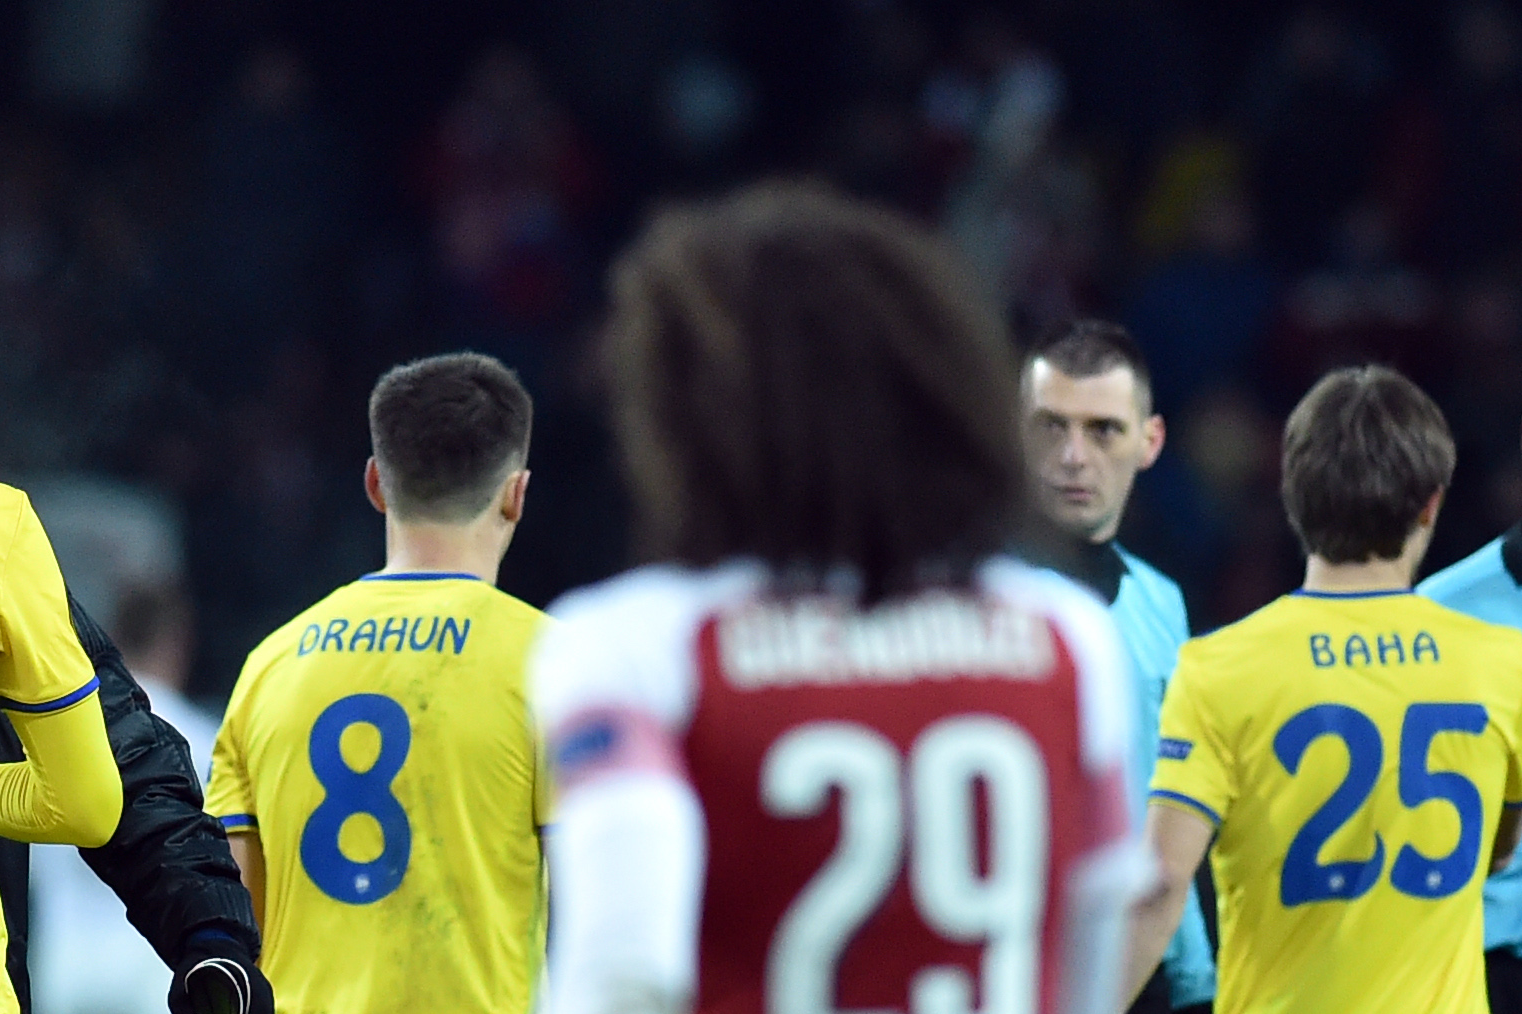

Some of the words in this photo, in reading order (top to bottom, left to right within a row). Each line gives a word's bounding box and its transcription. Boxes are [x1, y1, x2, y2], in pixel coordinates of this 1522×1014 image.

[297, 616, 471, 657] DRAHUN
[1309, 631, 1439, 668] BAHA
[300, 693, 411, 905] 8
[1273, 702, 1489, 907] 25
